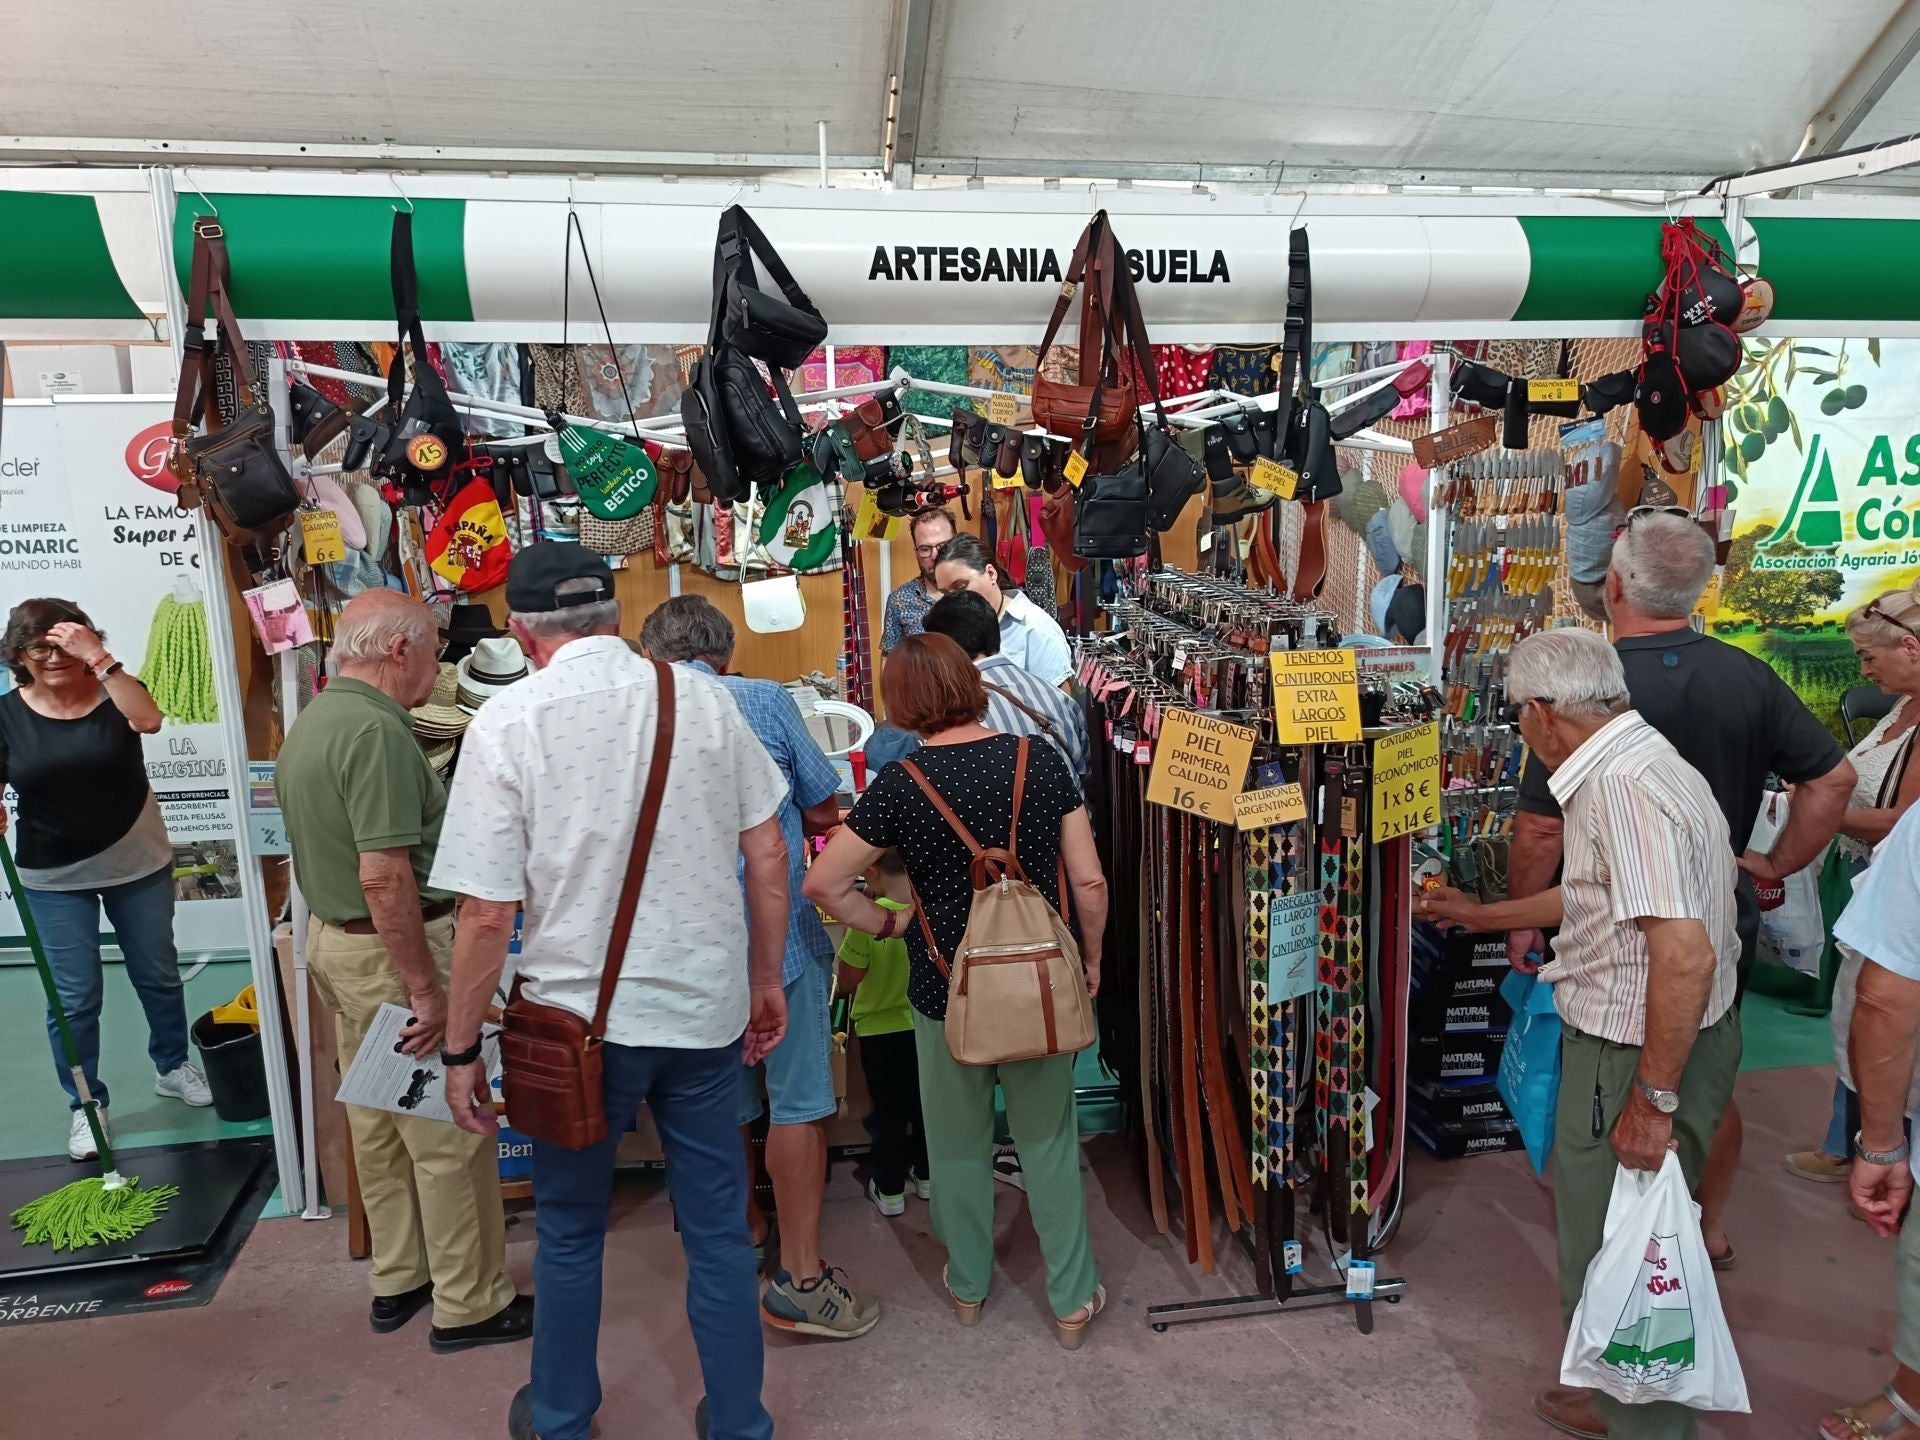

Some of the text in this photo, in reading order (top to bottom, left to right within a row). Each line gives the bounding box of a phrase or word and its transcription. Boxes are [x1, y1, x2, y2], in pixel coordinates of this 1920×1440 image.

[868, 246, 1063, 282] ARTESANIA
[418, 443, 442, 463] 15
[576, 442, 627, 490] PERFECTO
[603, 468, 648, 512] BÉTICO
[105, 505, 194, 520] LA FAMO
[301, 511, 337, 523] SOPORTES
[12, 523, 67, 533] LIMPIEZA
[303, 521, 338, 532] CATAVINO
[445, 520, 495, 544] ESPAÑA
[113, 525, 176, 547] Super
[160, 552, 184, 566] DE
[317, 548, 336, 561] 6 €
[1753, 554, 1836, 569] Asociación
[1841, 553, 1896, 570] Agraria
[1, 560, 50, 570] MUNDO
[1283, 650, 1345, 664] TENEMOS
[1274, 670, 1356, 684] CINTURONES
[1296, 690, 1338, 703] EXTRA
[1292, 707, 1346, 721] LARGOS
[1166, 707, 1255, 743] CINTURONES
[1305, 726, 1339, 741] PIEL
[1380, 724, 1432, 750] CINTURONES
[169, 737, 198, 756] LA
[1185, 732, 1224, 757] PIEL
[1397, 748, 1416, 761] PIEL
[1171, 749, 1231, 777] PRIMERA
[1374, 754, 1439, 785] ECONÓMICOS
[1167, 765, 1228, 791] CALIDAD
[181, 791, 226, 799] DIFERENCIAS
[1172, 786, 1211, 815] 16 €
[1233, 782, 1301, 806] CINTURONES
[165, 802, 217, 811] ABSORBENTE
[1236, 796, 1303, 818] ARGENTINOS
[191, 812, 226, 821] PELUSAS
[1262, 813, 1282, 825] 30 €
[180, 824, 210, 832] MENOS
[212, 823, 233, 831] PESO
[1273, 914, 1283, 927] EL
[1284, 908, 1312, 924] LARGO
[1291, 923, 1306, 937] LOS
[1455, 978, 1495, 990] NATURAL
[1446, 1006, 1490, 1016] NATURAL
[1446, 1015, 1489, 1023] WILDLIFE
[1442, 1053, 1485, 1063] NATURAL
[1441, 1061, 1484, 1070] WILDLIFE
[1462, 1101, 1503, 1115] NATURAL
[1467, 1137, 1506, 1148] NATURAL
[13, 1295, 38, 1306] LA
